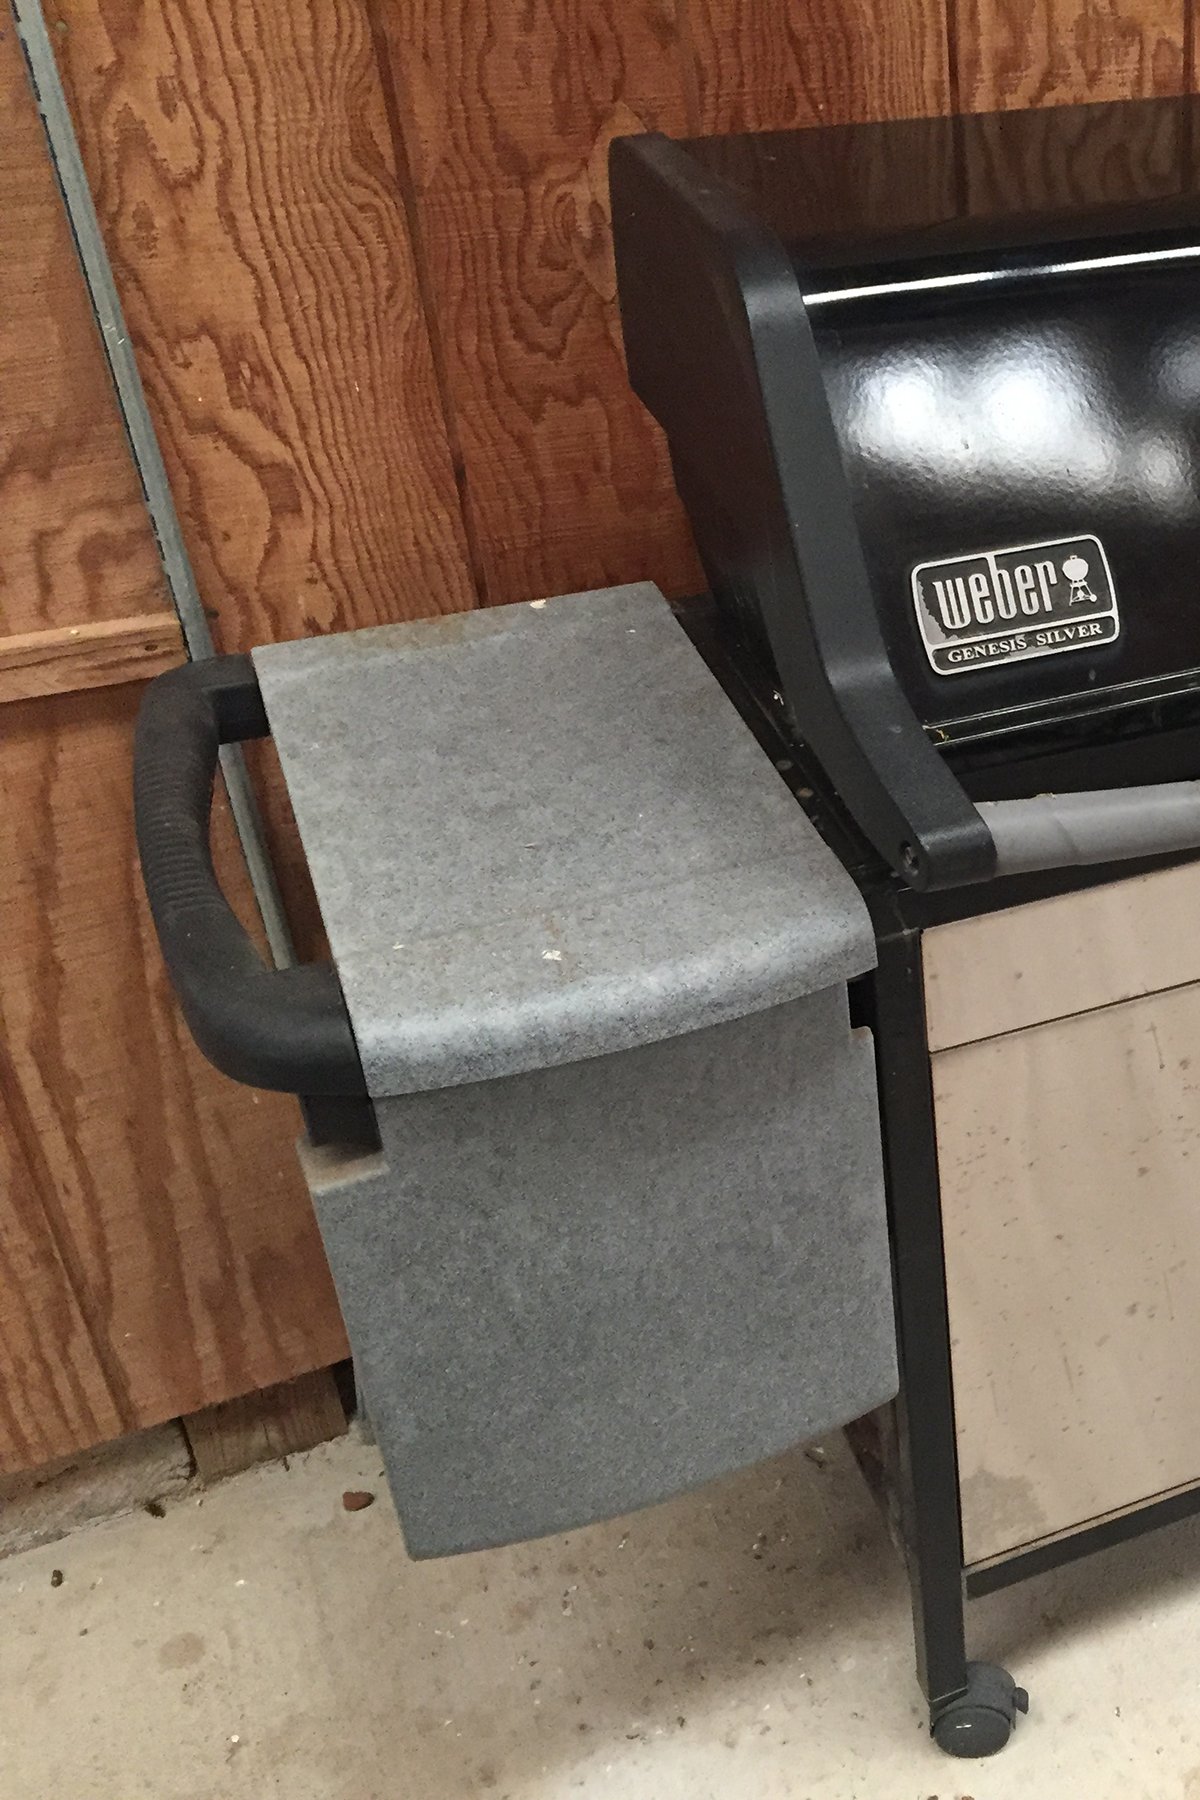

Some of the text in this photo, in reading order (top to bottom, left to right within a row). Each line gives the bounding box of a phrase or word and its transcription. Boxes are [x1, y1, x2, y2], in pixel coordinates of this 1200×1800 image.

[932, 555, 1058, 630] weber
[947, 622, 1103, 663] GENESIS SILVER
